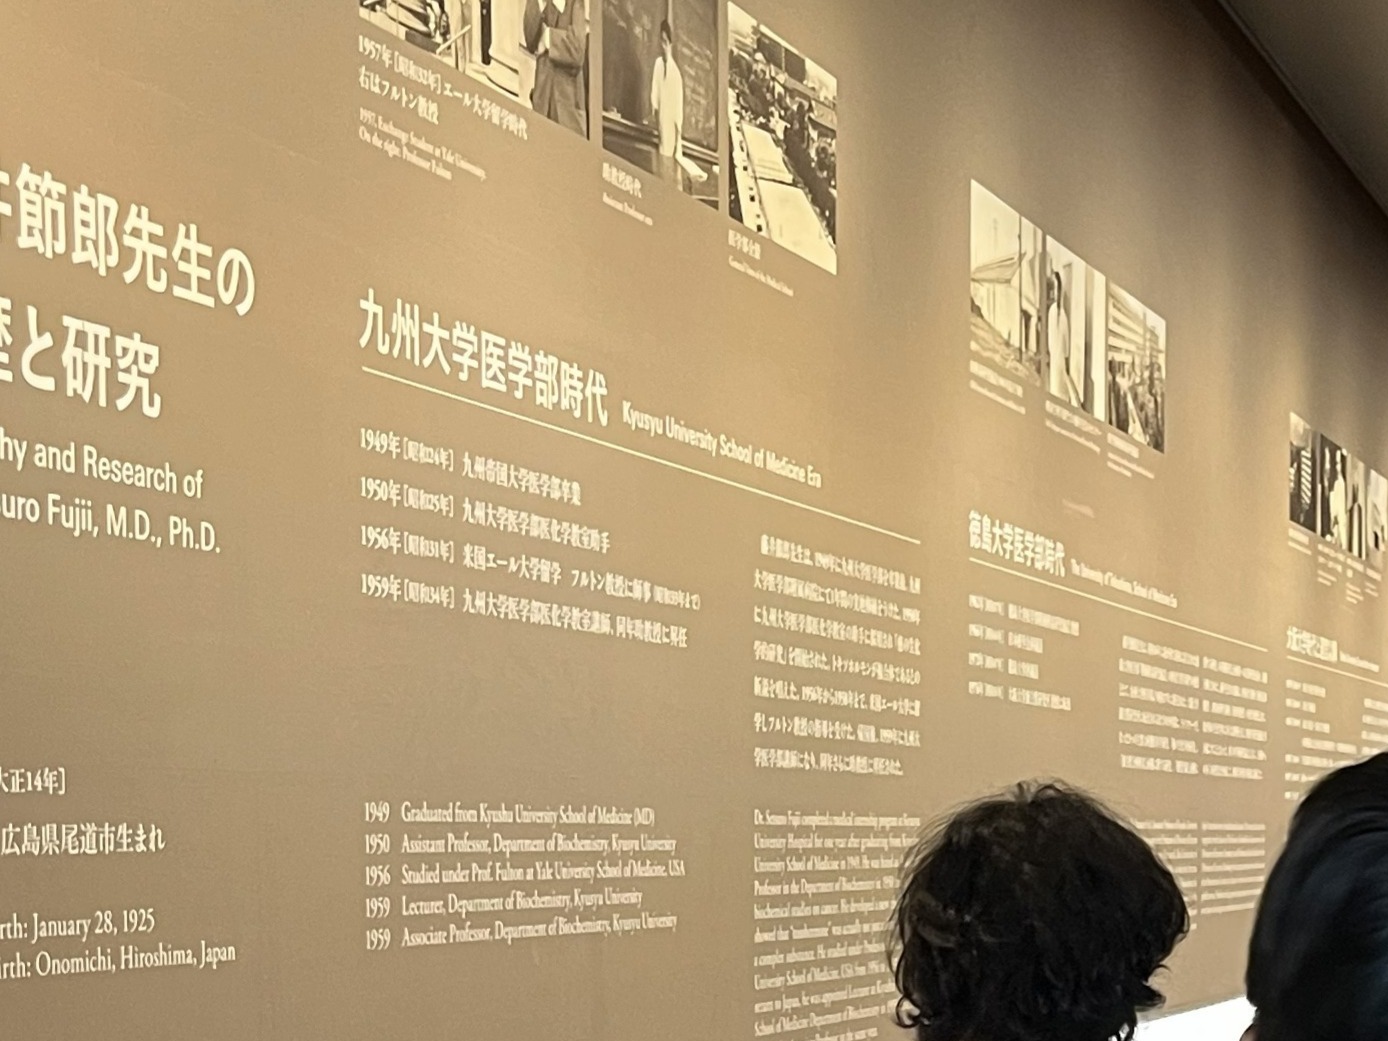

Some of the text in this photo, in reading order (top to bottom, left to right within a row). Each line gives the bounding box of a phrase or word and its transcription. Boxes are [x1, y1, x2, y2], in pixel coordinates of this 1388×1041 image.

[0, 162, 256, 316] 節郎先生の
[359, 287, 609, 427] 九州大学医学部時代
[622, 399, 823, 489] Kyusyu University School of Medicine Era
[35, 441, 76, 474] and
[84, 444, 178, 495] Research
[184, 469, 204, 499] of
[47, 493, 99, 537] Fujii,
[107, 503, 163, 548] M.D.,
[169, 515, 221, 554] Ph.D.
[365, 801, 390, 823] 1949
[401, 801, 453, 823] Graduated
[454, 801, 478, 823] from
[515, 803, 559, 829] University
[559, 804, 586, 824] School
[587, 804, 598, 824] of
[597, 805, 633, 825] Medicine
[1, 822, 166, 856] 広島県尾道市生まれ
[365, 833, 390, 855] 1950
[401, 833, 446, 854] Assistant
[447, 831, 492, 855] Professor,
[493, 832, 546, 858] Department
[547, 831, 559, 852] of
[365, 864, 391, 887] 1956
[401, 862, 440, 885] Studied
[441, 862, 470, 883] under
[471, 861, 494, 883] Prof.
[495, 861, 524, 882] Fulton
[525, 867, 534, 881] at
[535, 860, 554, 881] Yale
[555, 860, 596, 884] University
[596, 859, 623, 879] School
[365, 896, 391, 919] 1959
[447, 893, 504, 919] Department
[505, 890, 516, 911] of
[31, 912, 91, 944] January
[95, 910, 118, 936] 28,
[122, 907, 155, 934] 1925
[366, 928, 392, 950] 1959
[402, 926, 448, 947] Associate
[494, 920, 548, 946] Department
[548, 915, 559, 936] of
[36, 945, 116, 977] Onomichi,
[120, 942, 197, 971] Hiroshima,
[199, 939, 237, 969] Japan
